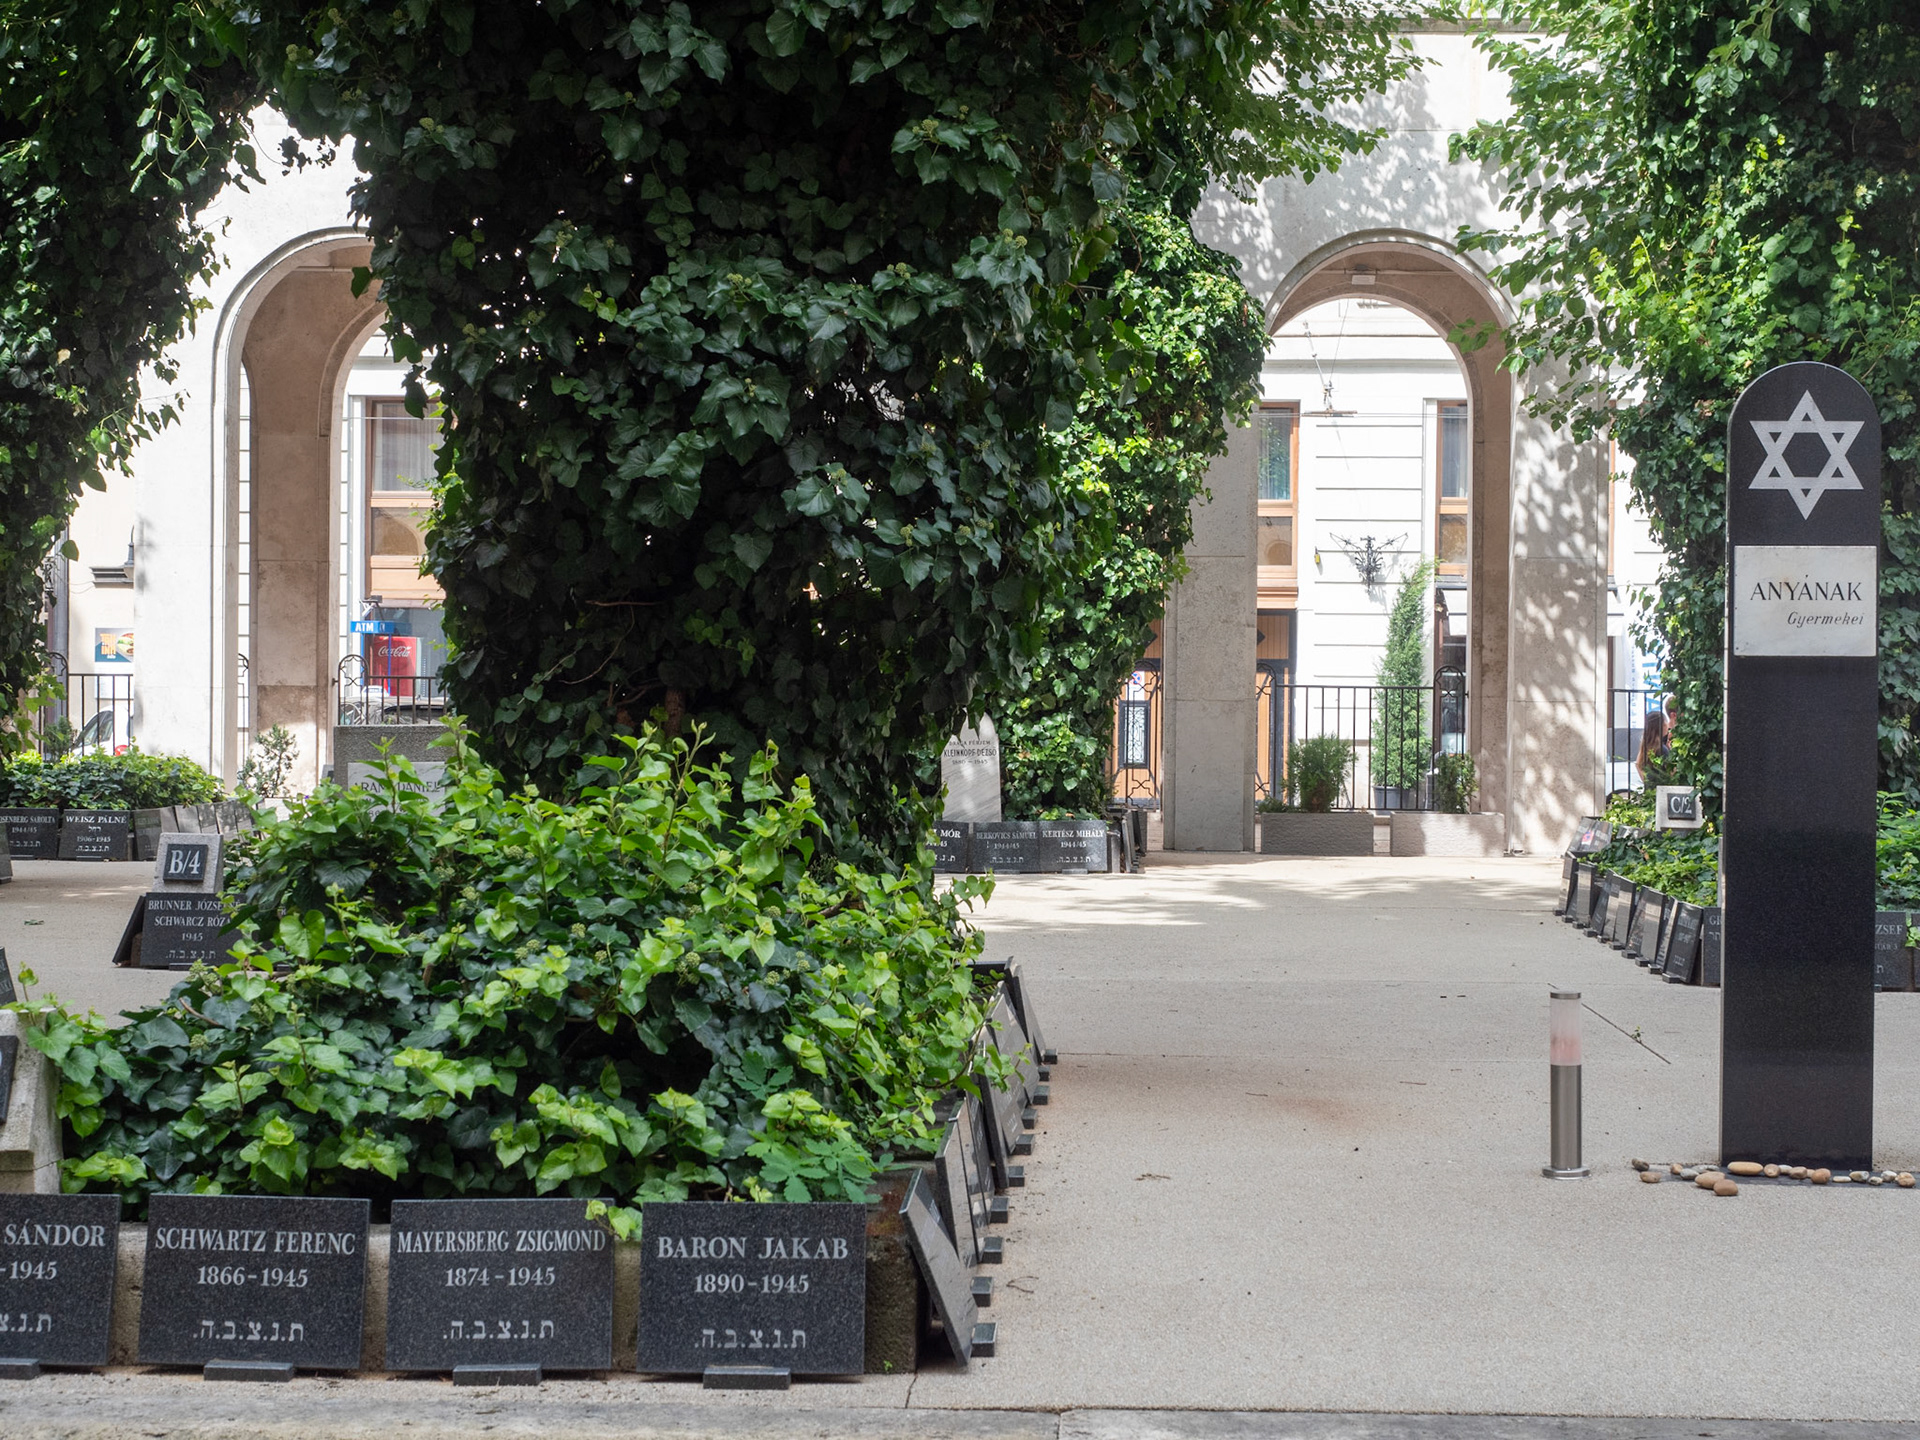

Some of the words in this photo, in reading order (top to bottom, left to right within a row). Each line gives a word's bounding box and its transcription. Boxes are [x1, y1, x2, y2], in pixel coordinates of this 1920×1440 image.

[1750, 574, 1862, 601] ANYÁNAK
[355, 622, 374, 632] ATM
[1787, 611, 1865, 628] Gyermekei
[1671, 796, 1692, 814] C/2
[65, 815, 95, 823] WEISZ
[97, 814, 127, 824] PÁLNÉ
[940, 829, 961, 839] MÓR
[1042, 828, 1074, 838] KERTÉSZ
[1075, 828, 1105, 838] MIHÁLY
[168, 849, 201, 875] B/4
[148, 900, 192, 911] BRUNNER
[154, 915, 204, 927] SCHWARCZ
[181, 932, 204, 942] 1945
[4, 1218, 105, 1247] SÁNDOR
[155, 1227, 266, 1252] SCHWARTZ
[273, 1230, 356, 1255] FERENC
[397, 1230, 510, 1253] MAYERSBERG
[515, 1229, 606, 1252] ZSIGMOND
[657, 1236, 748, 1259] BARON
[758, 1236, 849, 1260] JAKAB
[197, 1265, 309, 1288] 1866-1945
[694, 1273, 810, 1294] 1890-1945
